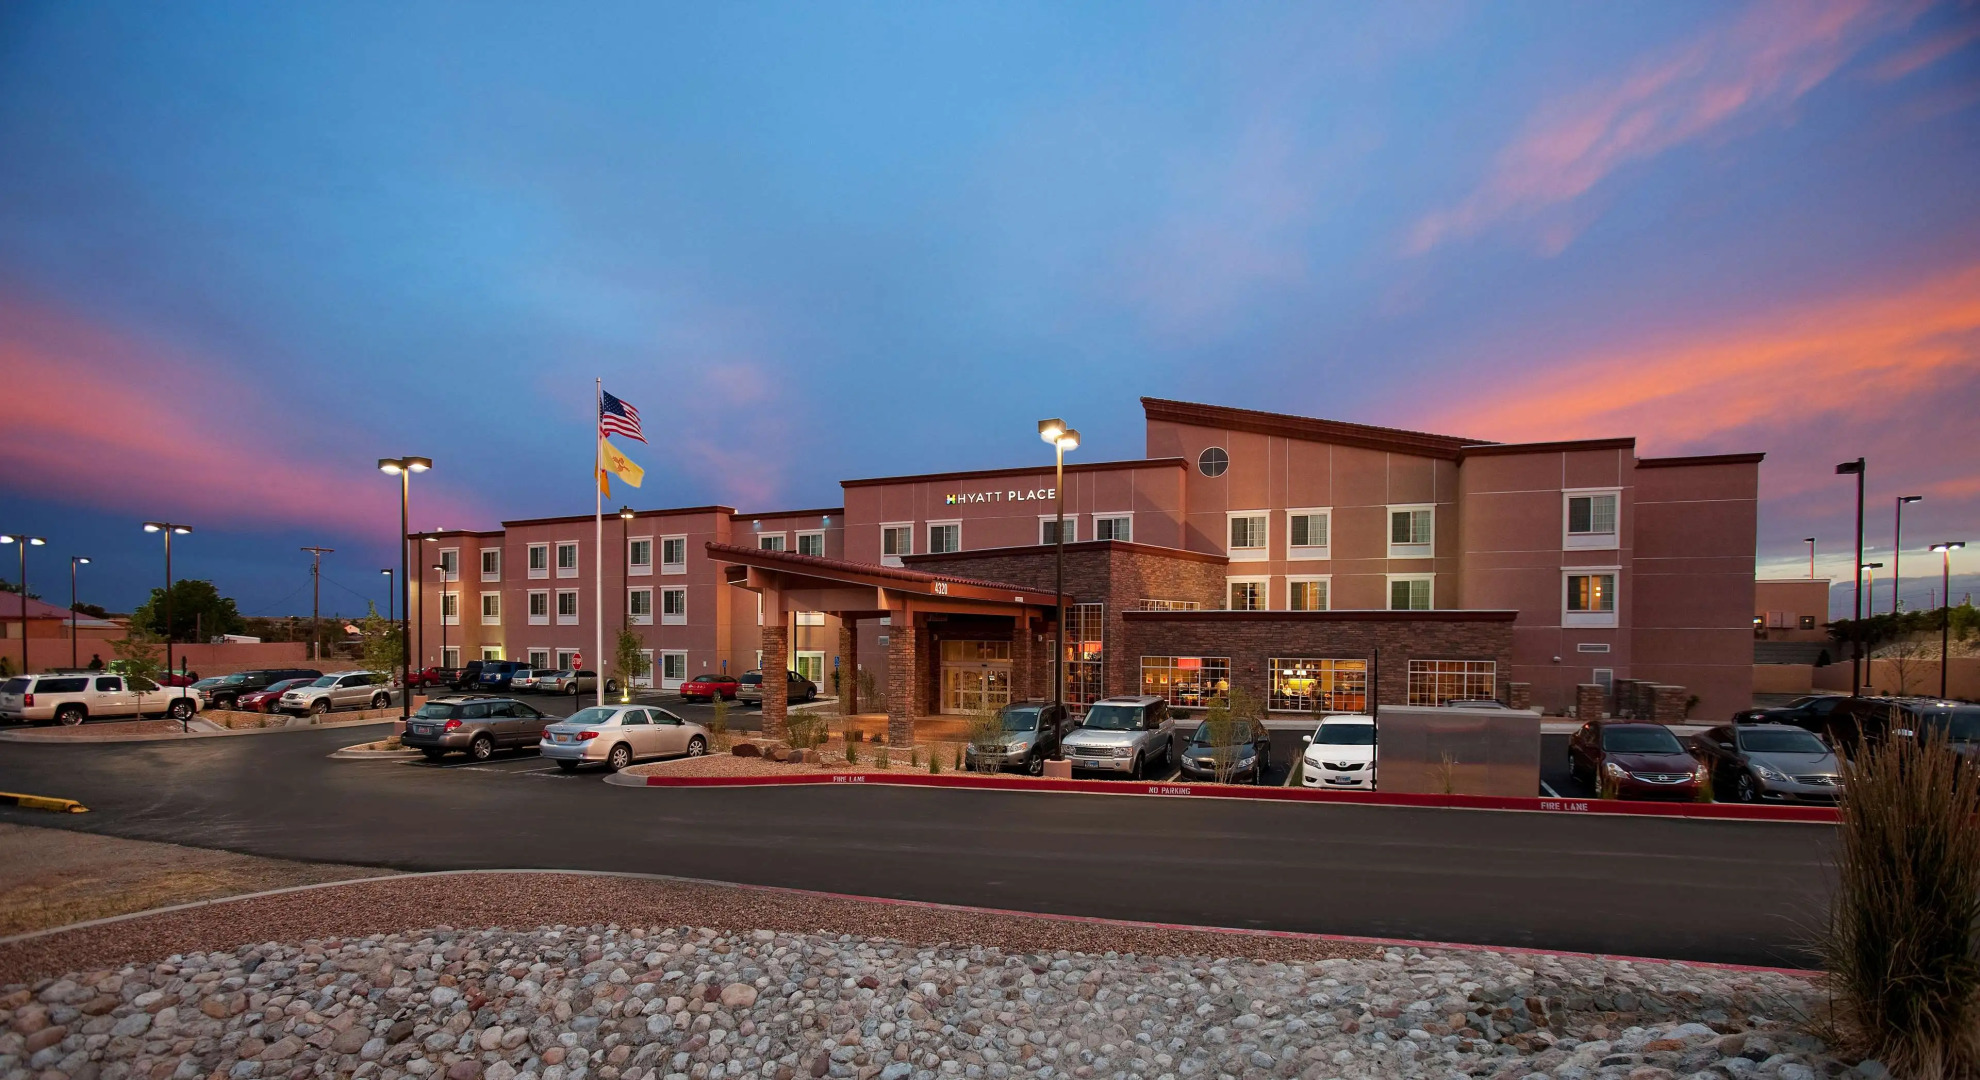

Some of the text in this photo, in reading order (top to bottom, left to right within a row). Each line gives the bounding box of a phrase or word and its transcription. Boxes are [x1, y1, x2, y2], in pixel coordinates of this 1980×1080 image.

[957, 488, 1056, 504] HYATT PLACE
[934, 582, 948, 595] 4320
[849, 775, 865, 783] LANE
[1148, 786, 1191, 795] NO PARKING
[1540, 801, 1588, 811] FIRE LANE
